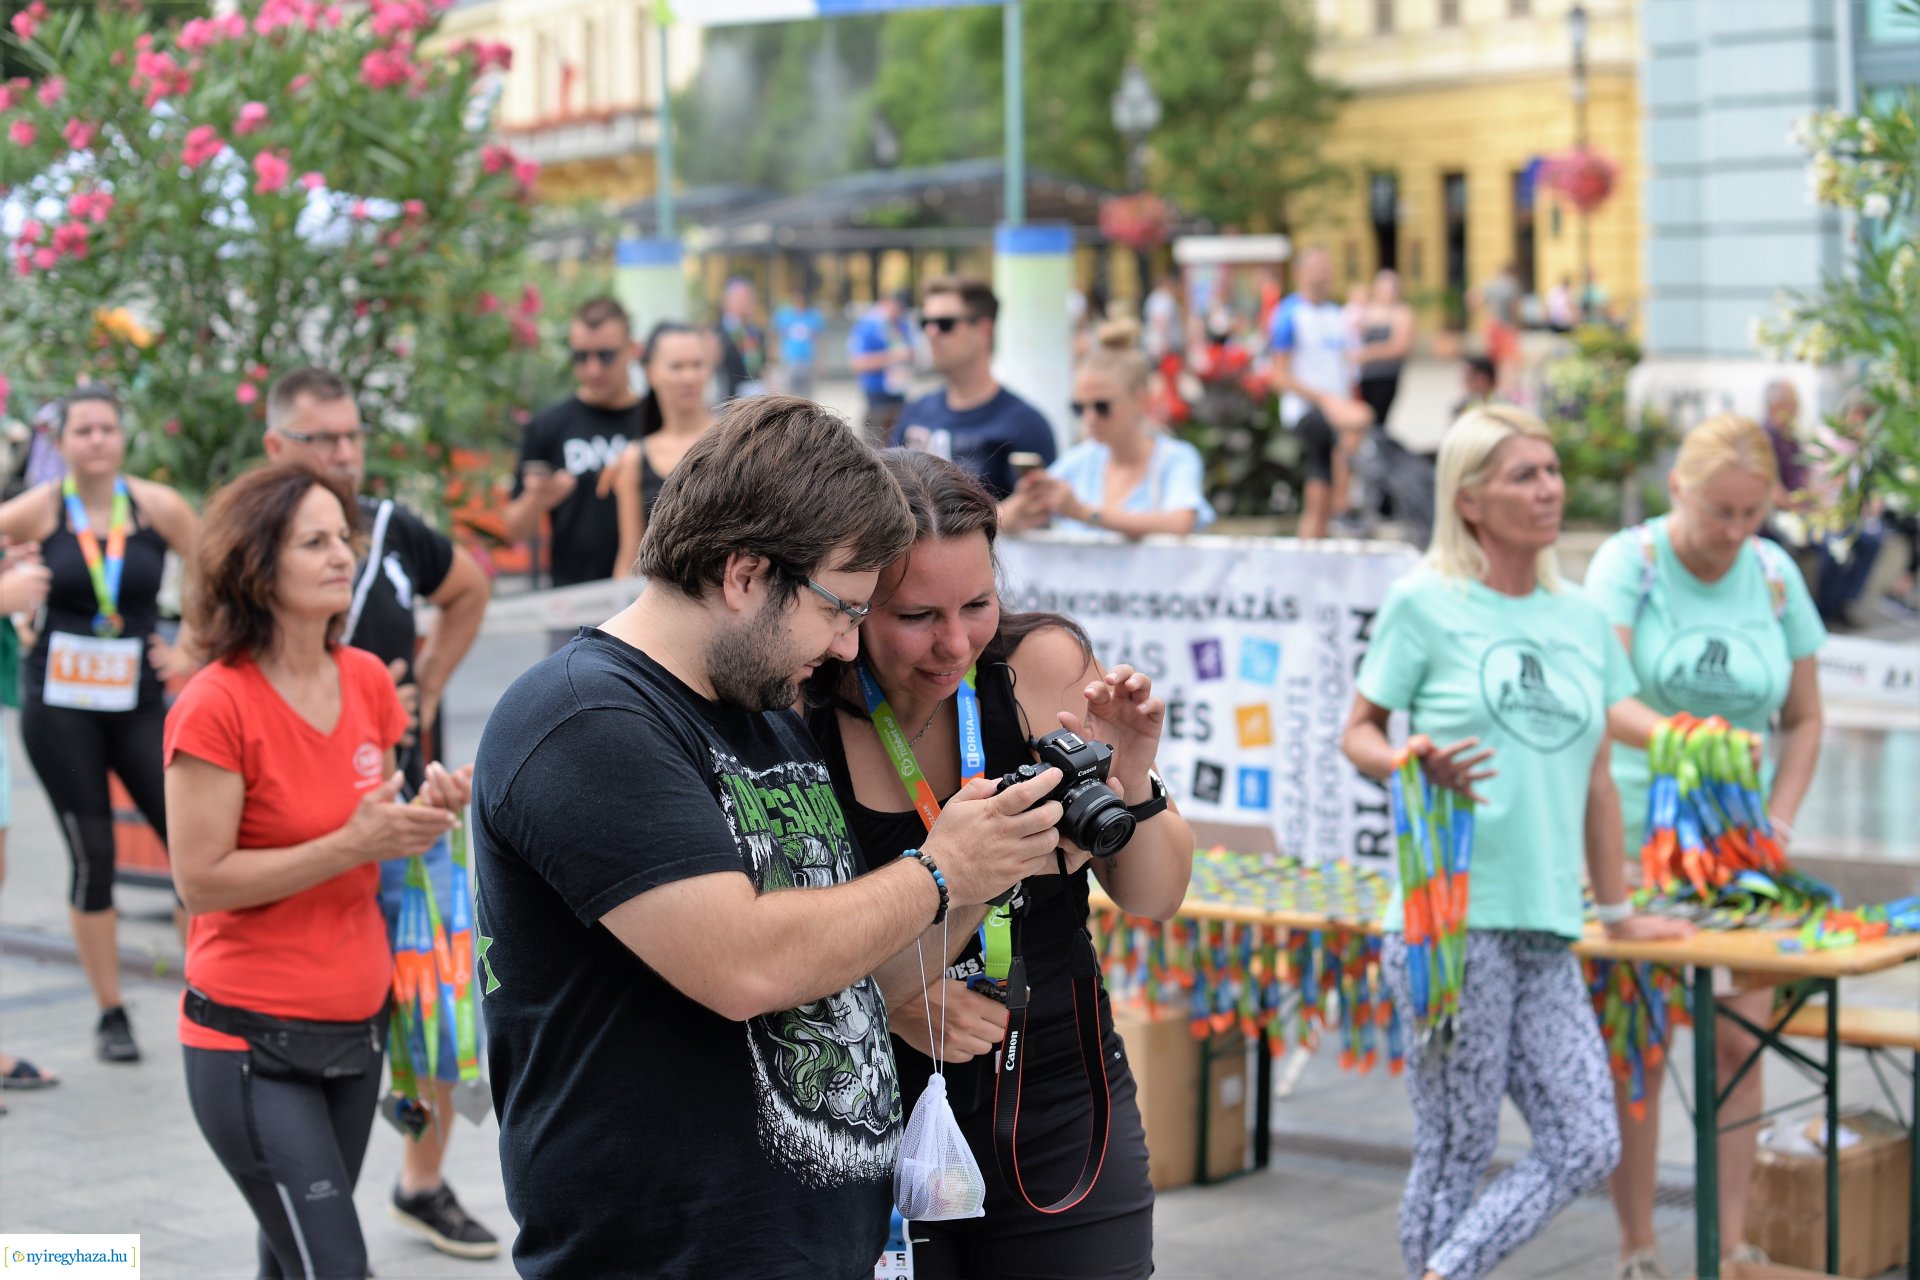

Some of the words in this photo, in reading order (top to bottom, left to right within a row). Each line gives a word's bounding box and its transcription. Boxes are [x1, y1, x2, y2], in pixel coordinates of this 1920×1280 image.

[1095, 631, 1167, 680] TÁS
[1077, 765, 1098, 777] Canon
[1004, 1030, 1019, 1071] Canon
